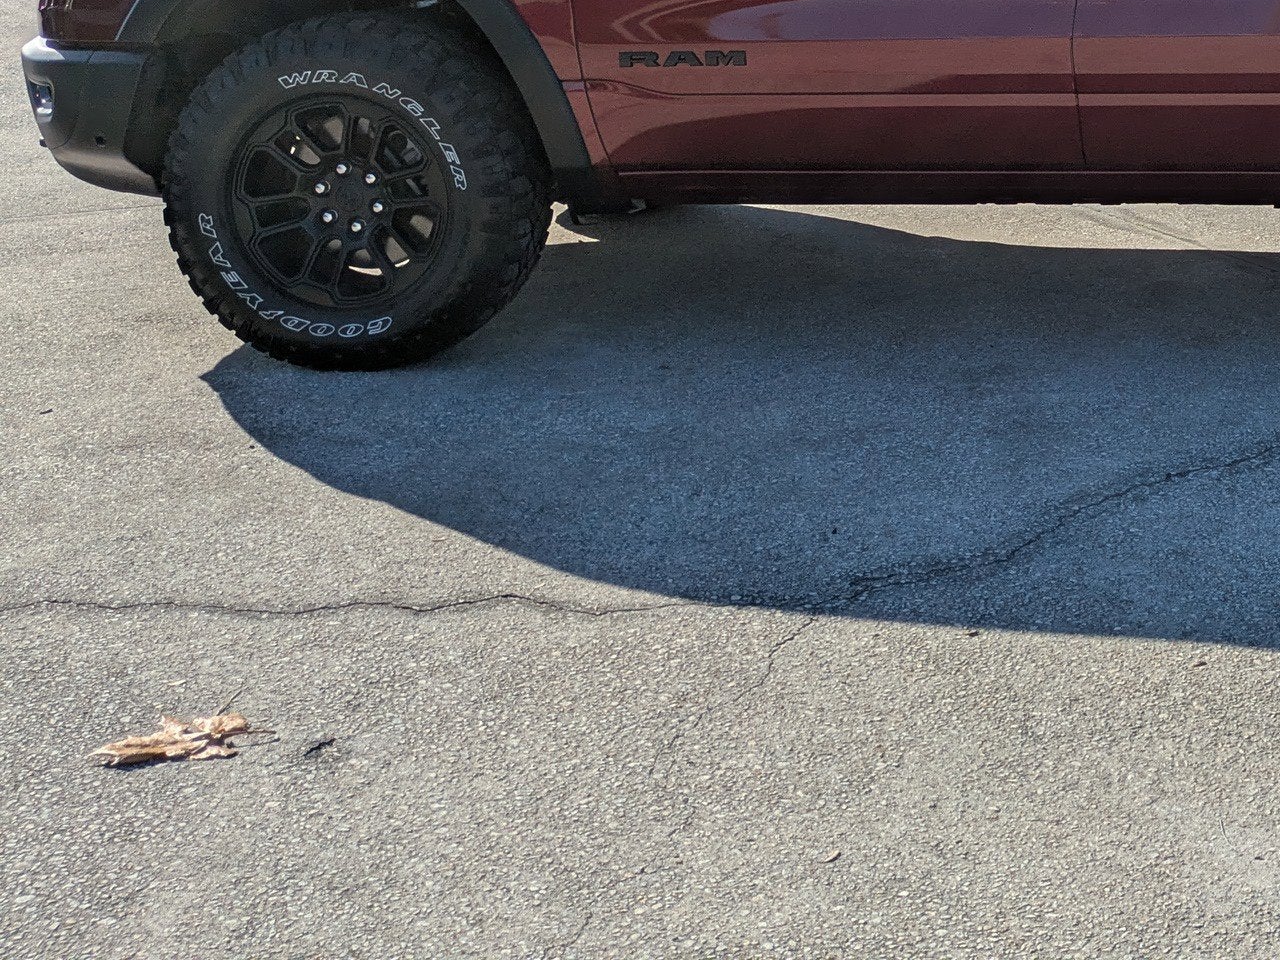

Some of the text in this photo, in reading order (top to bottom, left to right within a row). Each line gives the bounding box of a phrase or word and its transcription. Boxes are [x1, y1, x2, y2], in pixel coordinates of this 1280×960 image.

[619, 50, 747, 68] RAM
[278, 69, 467, 191] WRANGLER
[198, 212, 392, 338] GOODYEAR
